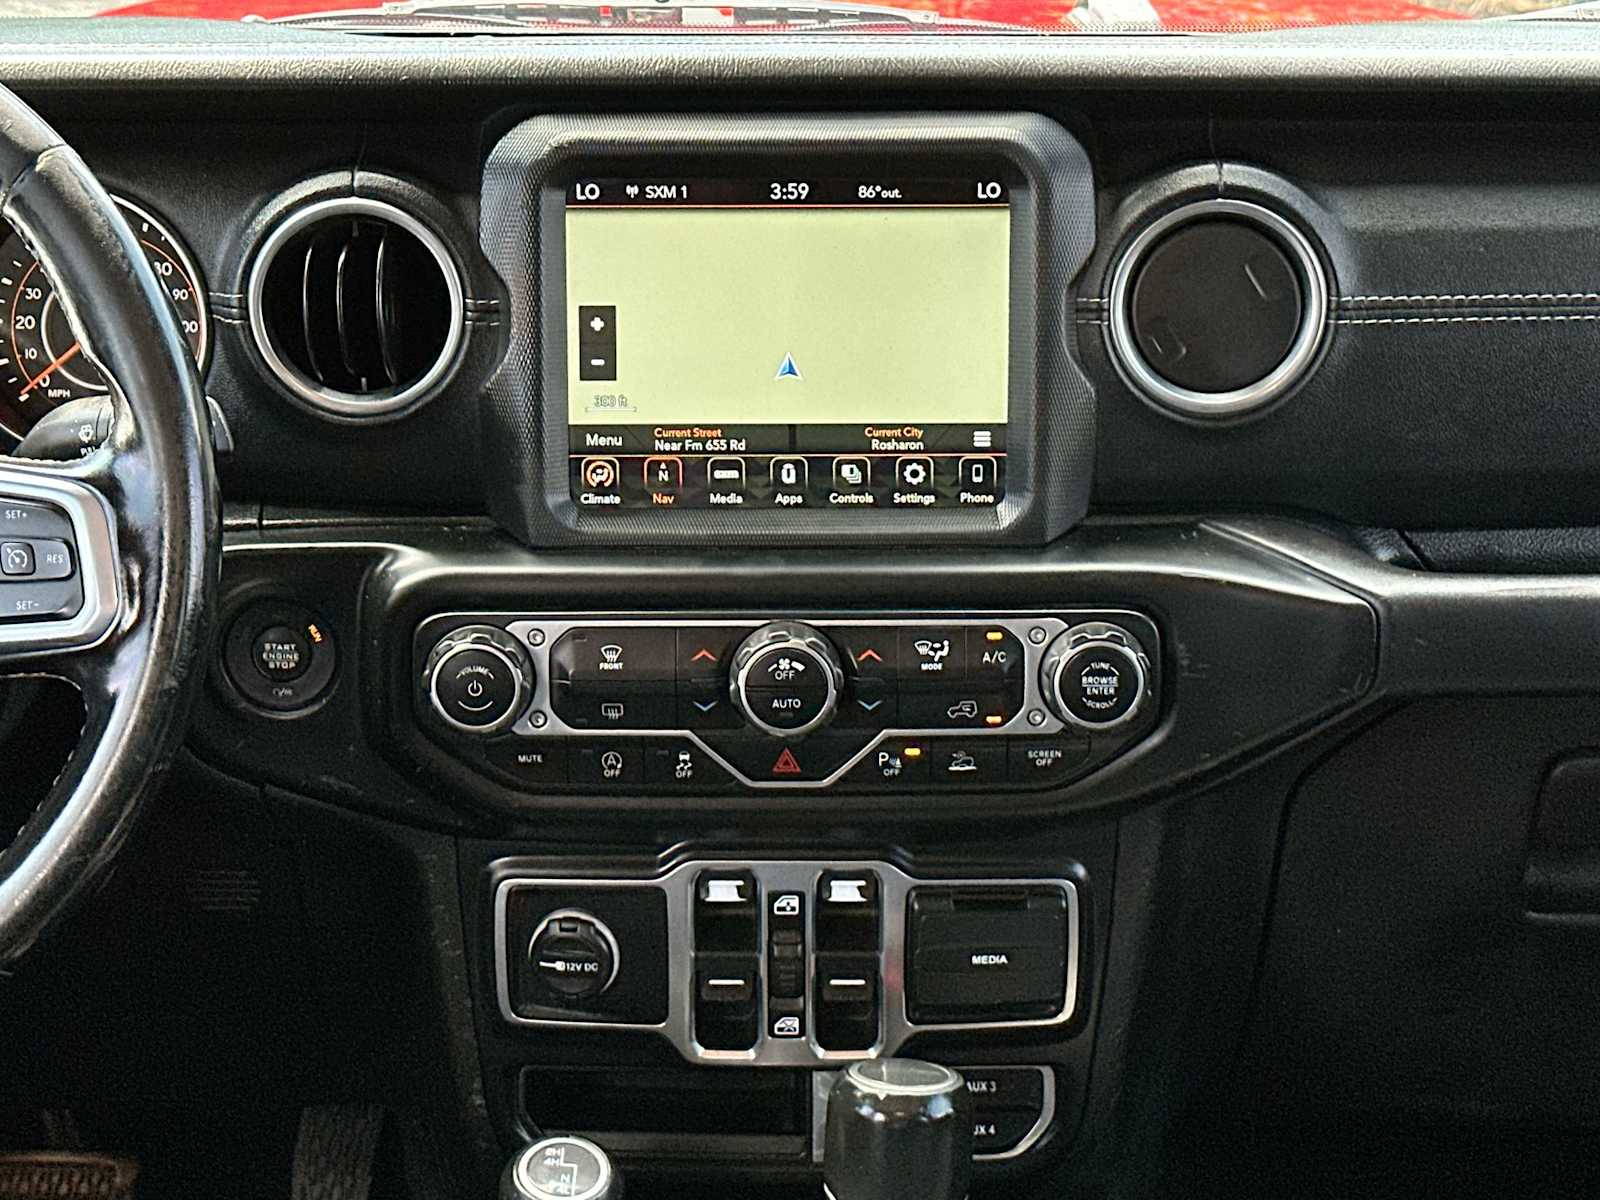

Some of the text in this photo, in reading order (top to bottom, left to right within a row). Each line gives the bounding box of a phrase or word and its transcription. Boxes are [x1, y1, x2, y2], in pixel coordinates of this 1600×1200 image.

[576, 183, 600, 200] LO
[645, 185, 688, 199] SXM 1
[770, 183, 809, 199] 3:59
[977, 182, 1002, 199] LO
[25, 288, 42, 300] 30
[172, 288, 189, 301] 90
[15, 316, 36, 330] 20
[24, 348, 37, 359] 10
[48, 388, 71, 399] MPH
[654, 428, 722, 438] Current Street
[864, 427, 924, 439] Current City
[585, 433, 623, 447] Menu
[654, 440, 746, 451] Near Fm 655 Rd
[871, 440, 924, 451] Rosharon
[580, 494, 621, 505] Climate
[652, 494, 675, 505] Nav
[709, 494, 744, 504] Media
[775, 493, 803, 505] Apps
[829, 493, 874, 504] Controls
[893, 493, 936, 505] Settings
[960, 493, 994, 504] Phone
[46, 554, 64, 564] RES
[264, 643, 296, 651] START
[262, 651, 299, 661] ENGINE
[982, 651, 1007, 663] A/C
[268, 661, 296, 669] STOP
[599, 662, 624, 670] FRONT
[920, 663, 944, 671] MODE
[1090, 661, 1112, 671] TUNE
[774, 670, 796, 681] OFF
[1082, 676, 1118, 684] BROWSE
[1086, 686, 1116, 696] ENTER
[772, 699, 801, 709] AUTO
[518, 754, 543, 763] MUTE
[1027, 750, 1062, 758] SCREEN
[1035, 758, 1052, 766] OFF
[603, 768, 621, 778] OFF
[675, 769, 693, 778] OFF
[883, 768, 900, 777] OFF
[971, 954, 1009, 965] MEDIA
[566, 962, 599, 972] 12V DC
